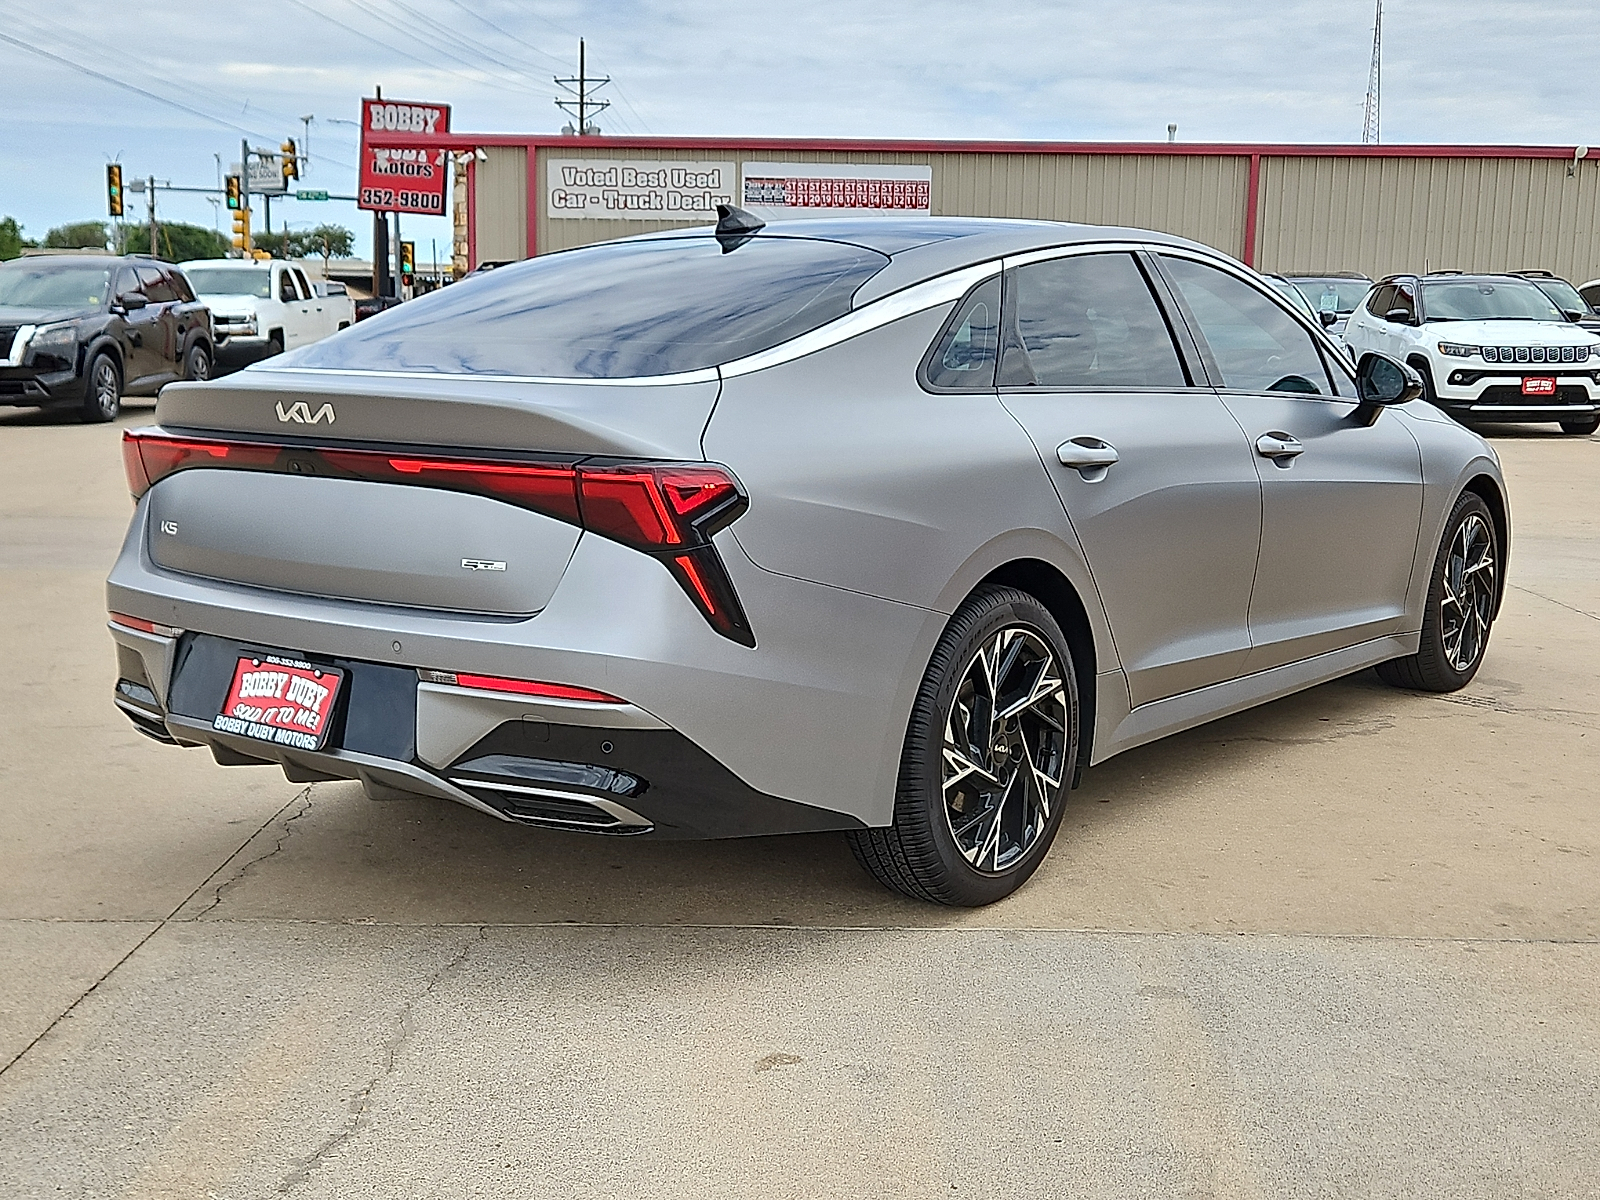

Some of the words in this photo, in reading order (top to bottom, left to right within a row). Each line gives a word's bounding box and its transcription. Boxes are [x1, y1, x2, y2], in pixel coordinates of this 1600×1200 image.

[370, 104, 440, 133] BOBBY
[562, 167, 617, 187] Voted
[622, 168, 667, 188] Best
[671, 169, 721, 189] Used
[362, 189, 440, 210] 352-9800
[552, 189, 586, 208] Car
[603, 190, 663, 210] Truck
[275, 400, 336, 425] KIA
[239, 671, 289, 698] BOBBY
[285, 674, 329, 711] DUBY
[232, 702, 262, 721] SOLD
[260, 706, 279, 724] IT
[275, 706, 295, 724] TO
[213, 715, 250, 736] BOBBY
[247, 723, 276, 742] DUBY
[275, 728, 318, 750] MOTORS
